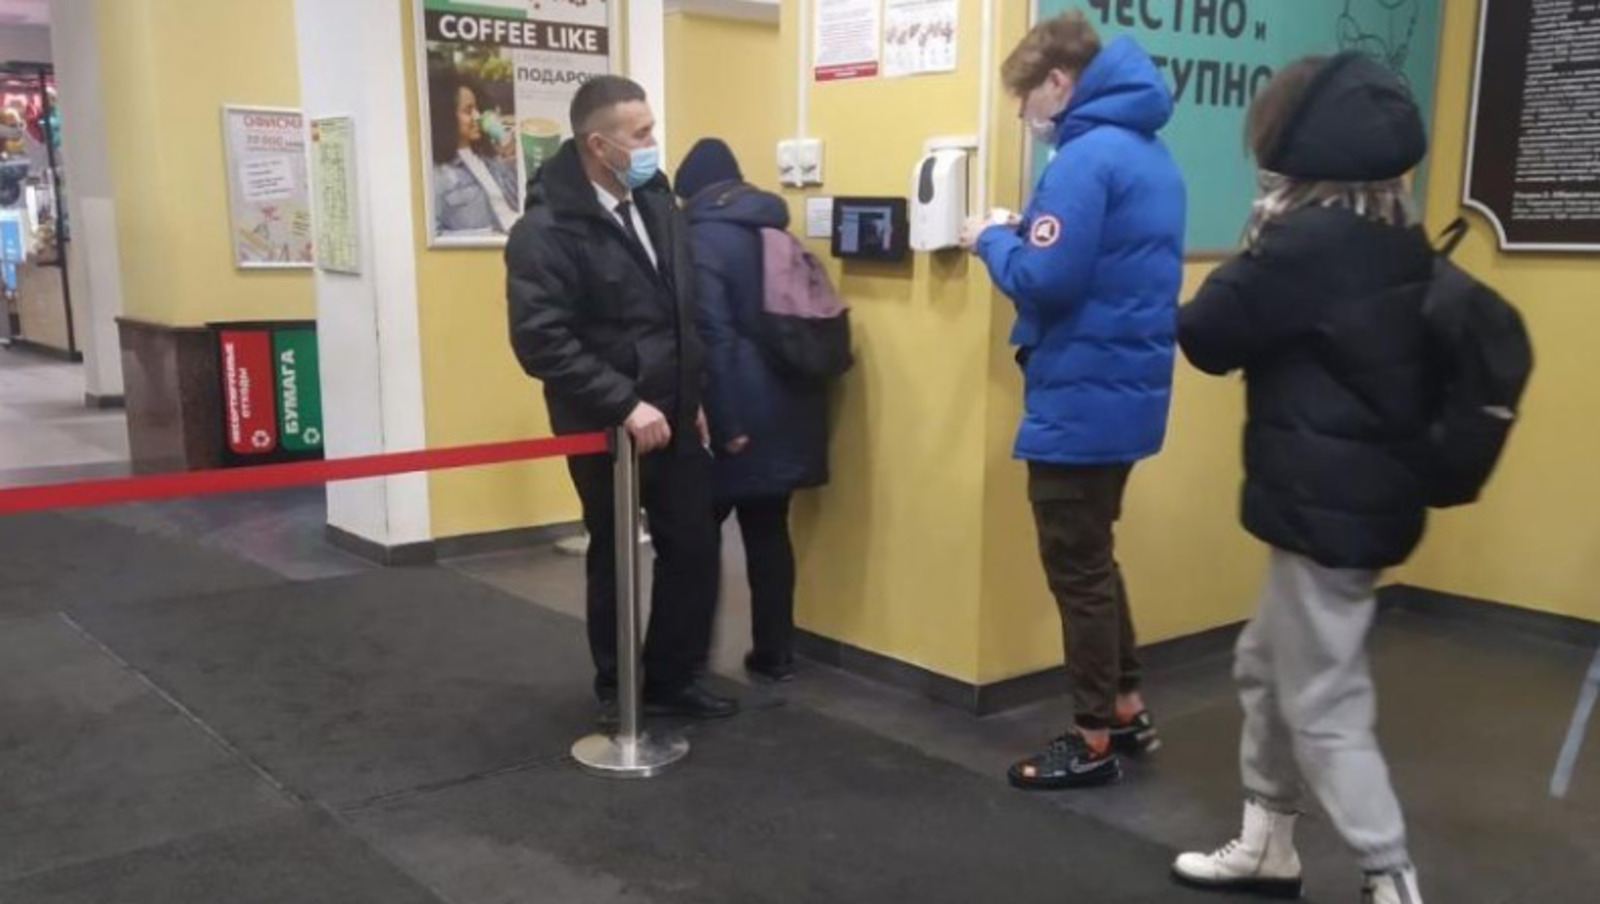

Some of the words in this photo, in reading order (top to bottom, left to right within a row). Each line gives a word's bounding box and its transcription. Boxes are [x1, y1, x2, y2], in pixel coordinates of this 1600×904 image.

[439, 16, 537, 45] COFFEE
[547, 26, 598, 51] LIKE
[517, 67, 596, 86] ПОДАРО
[281, 349, 299, 433] БУМАГА
